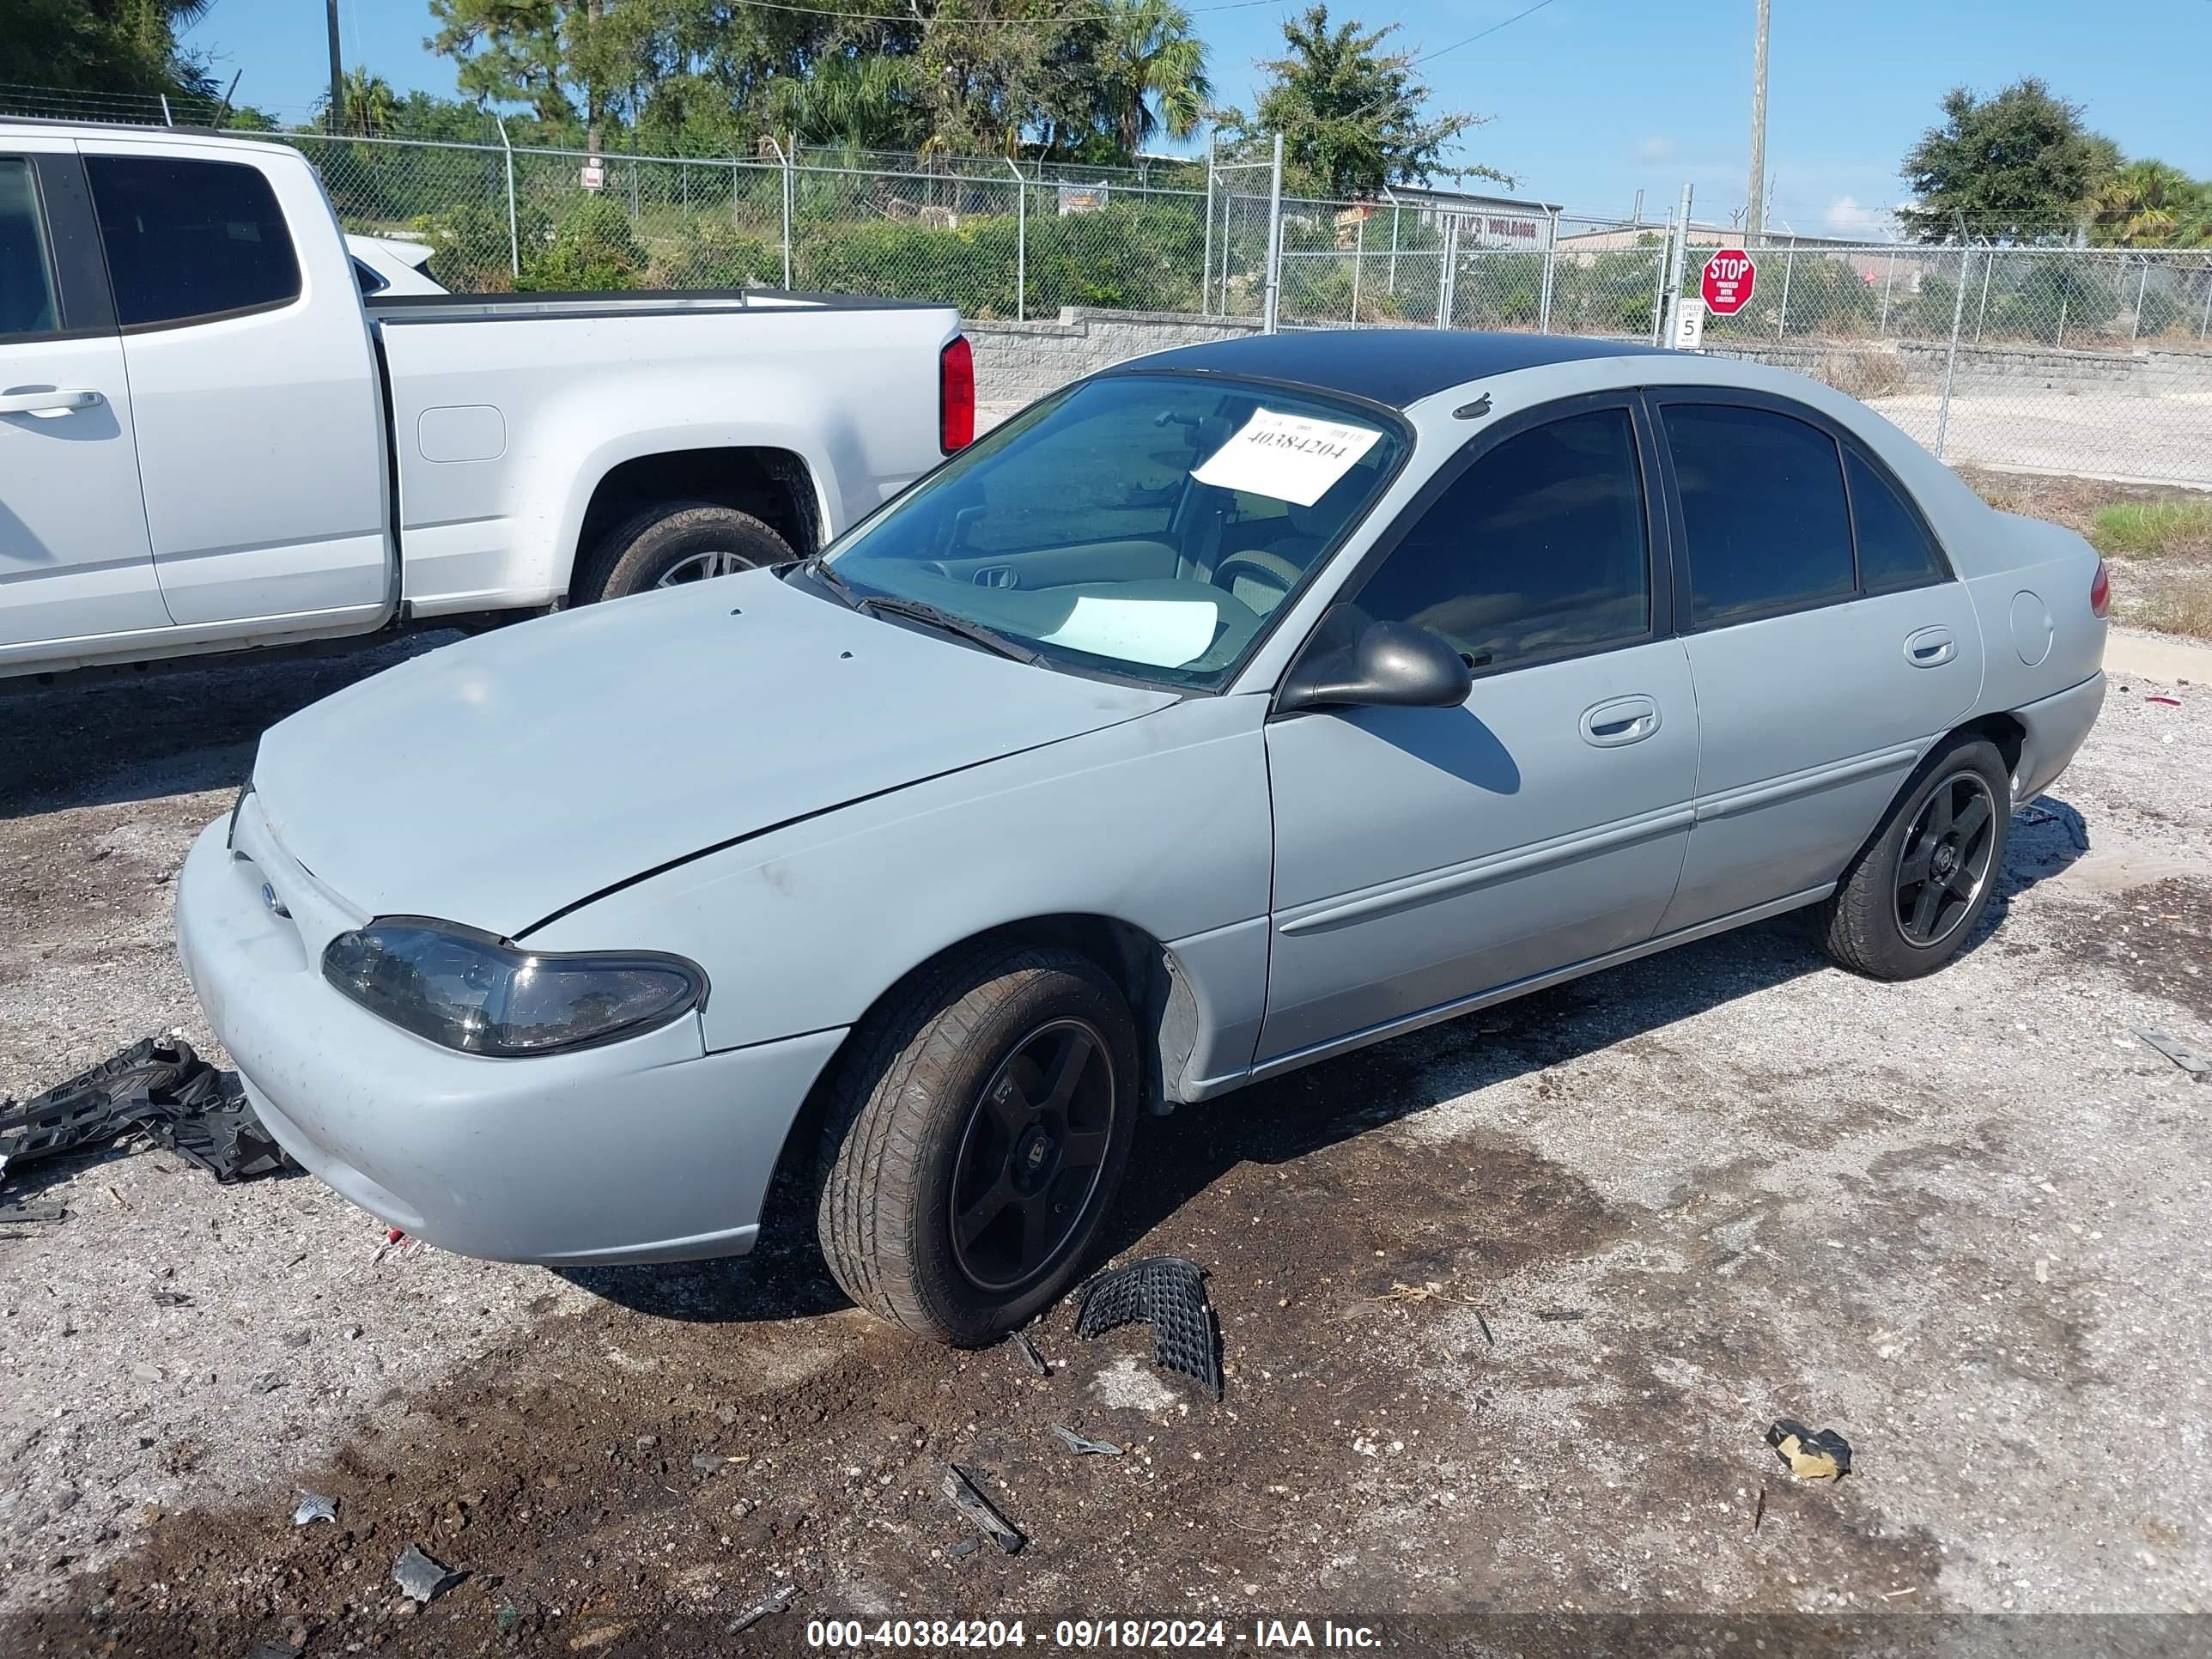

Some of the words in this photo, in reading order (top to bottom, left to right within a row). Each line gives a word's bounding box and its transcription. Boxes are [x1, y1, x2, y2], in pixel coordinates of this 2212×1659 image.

[1710, 258, 1749, 280] STOP
[1683, 319, 1695, 336] 5
[1248, 431, 1348, 459] 40384204
